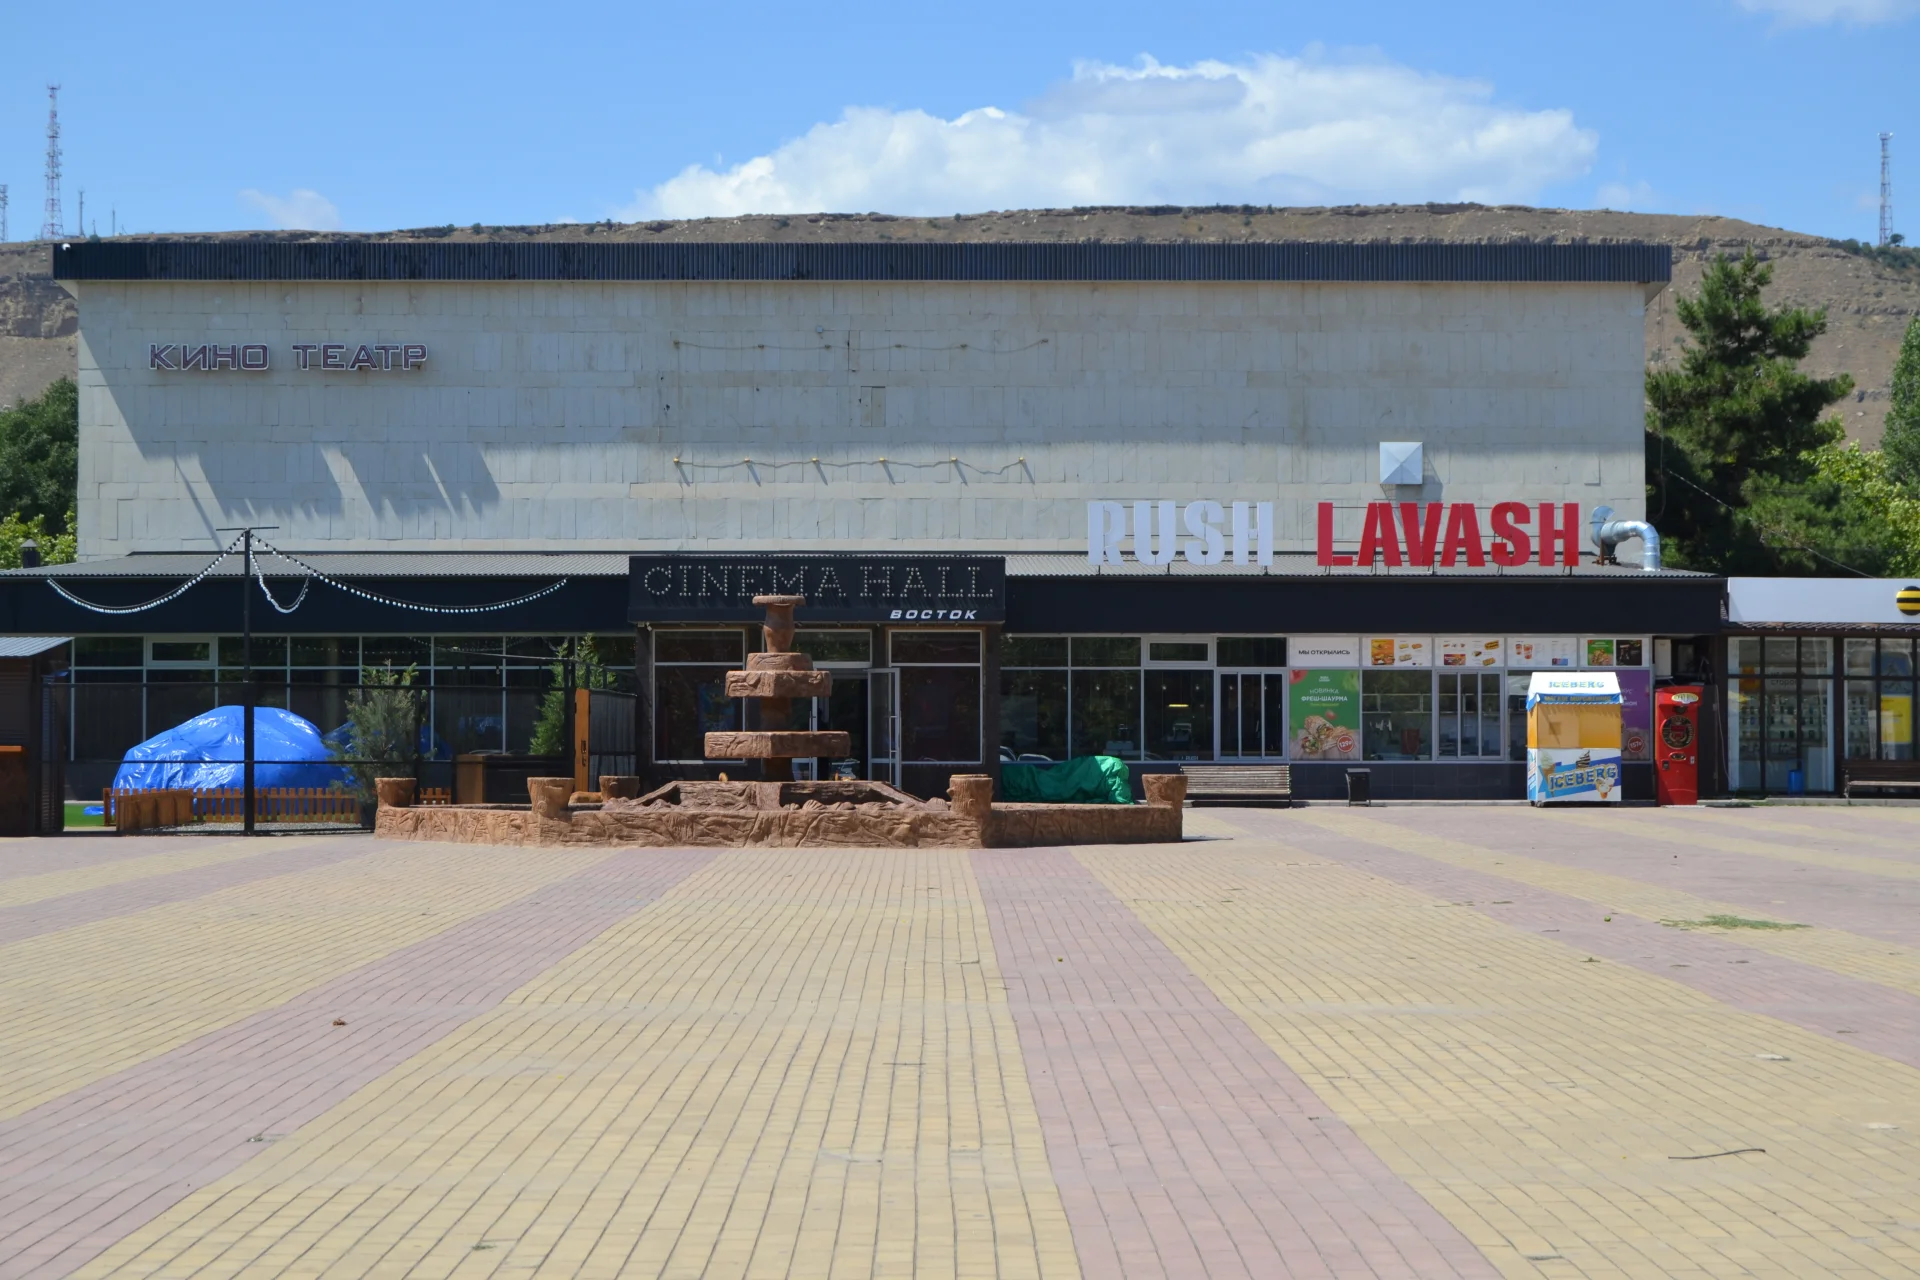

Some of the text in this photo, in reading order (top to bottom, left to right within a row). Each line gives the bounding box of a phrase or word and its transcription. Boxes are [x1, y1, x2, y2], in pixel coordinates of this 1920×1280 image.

[149, 343, 428, 371] КИНО ТЕАТР
[1087, 500, 1579, 567] RUSH LAVASH
[644, 565, 994, 598] CINEMA HALL
[890, 609, 978, 620] ВОСТОК
[1548, 681, 1605, 689] ICEBERG
[1549, 765, 1617, 790] ICEBERG
